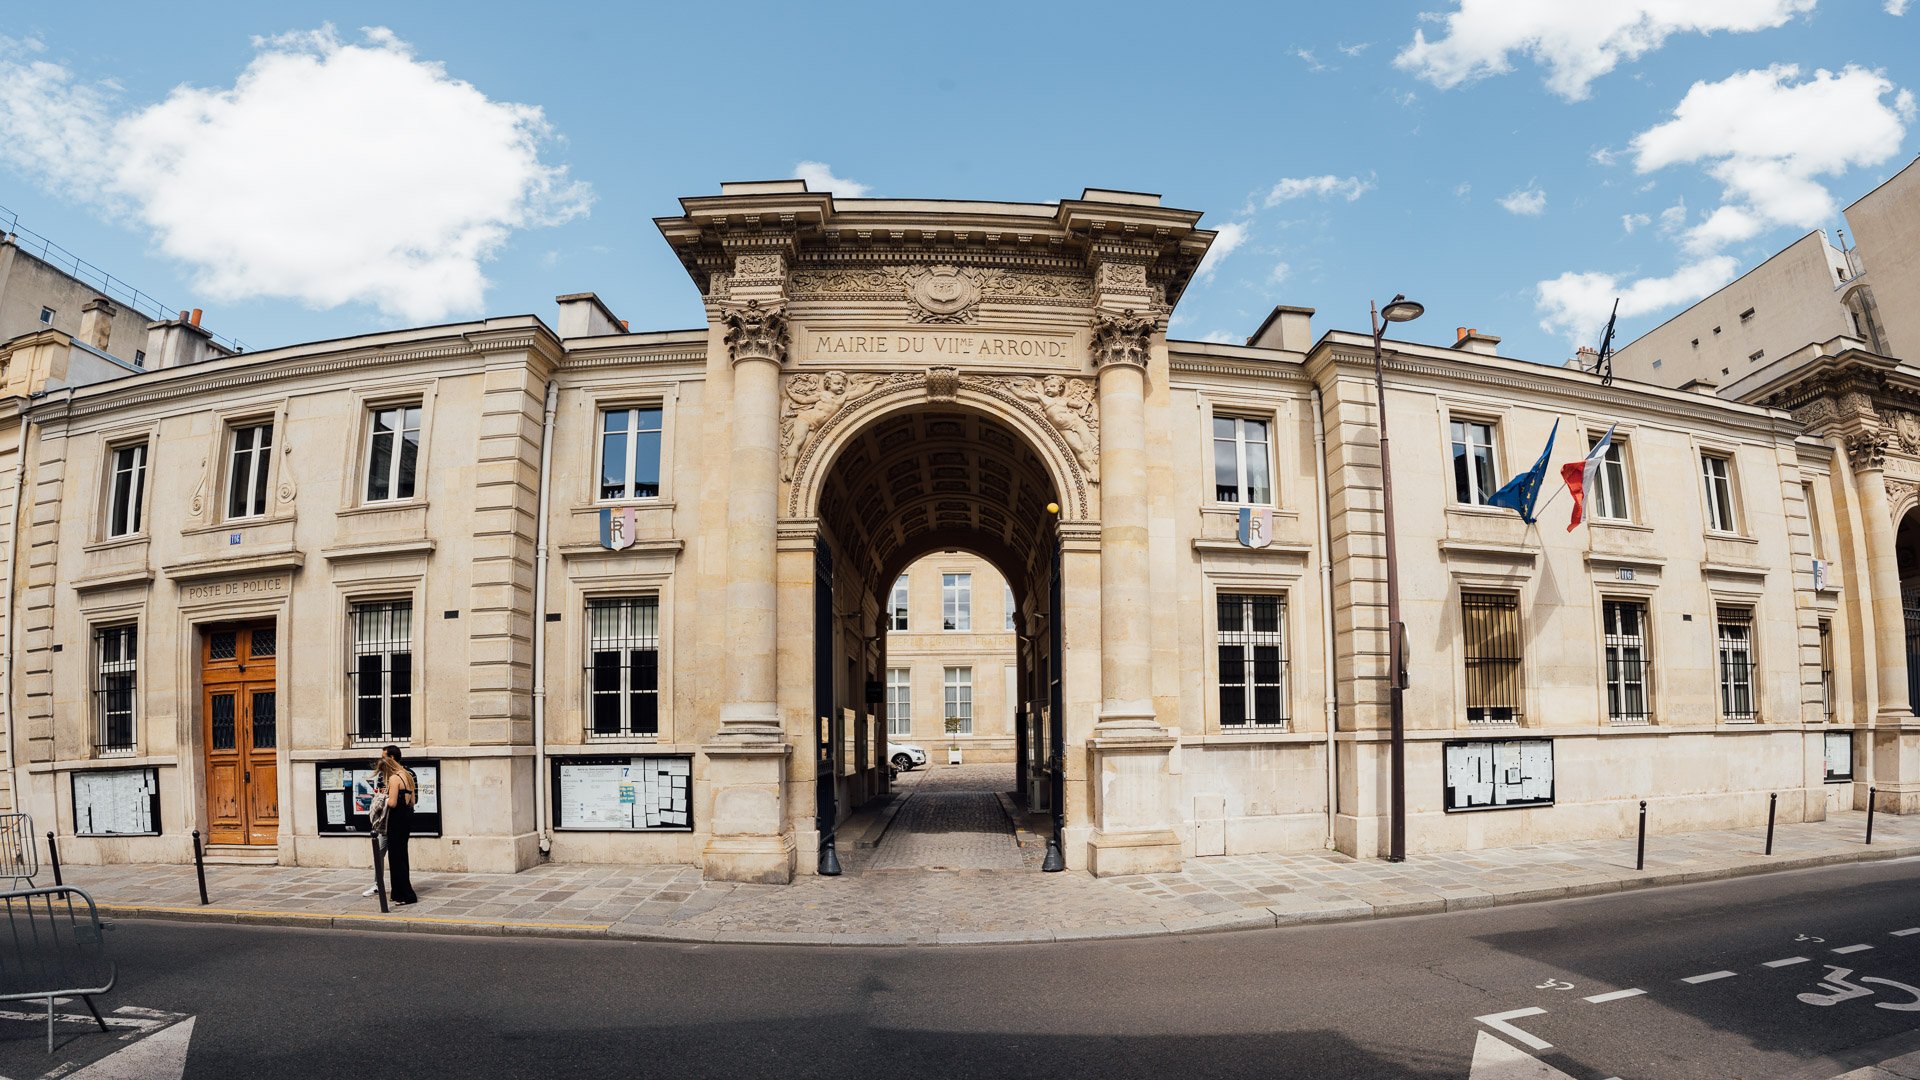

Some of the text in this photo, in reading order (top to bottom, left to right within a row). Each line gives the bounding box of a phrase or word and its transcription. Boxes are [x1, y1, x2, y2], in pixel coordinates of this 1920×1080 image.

[815, 335, 889, 353] MAIRIE
[897, 336, 925, 353] DU
[1621, 569, 1632, 580] 116
[189, 578, 281, 599] POSTE DE POLICE
